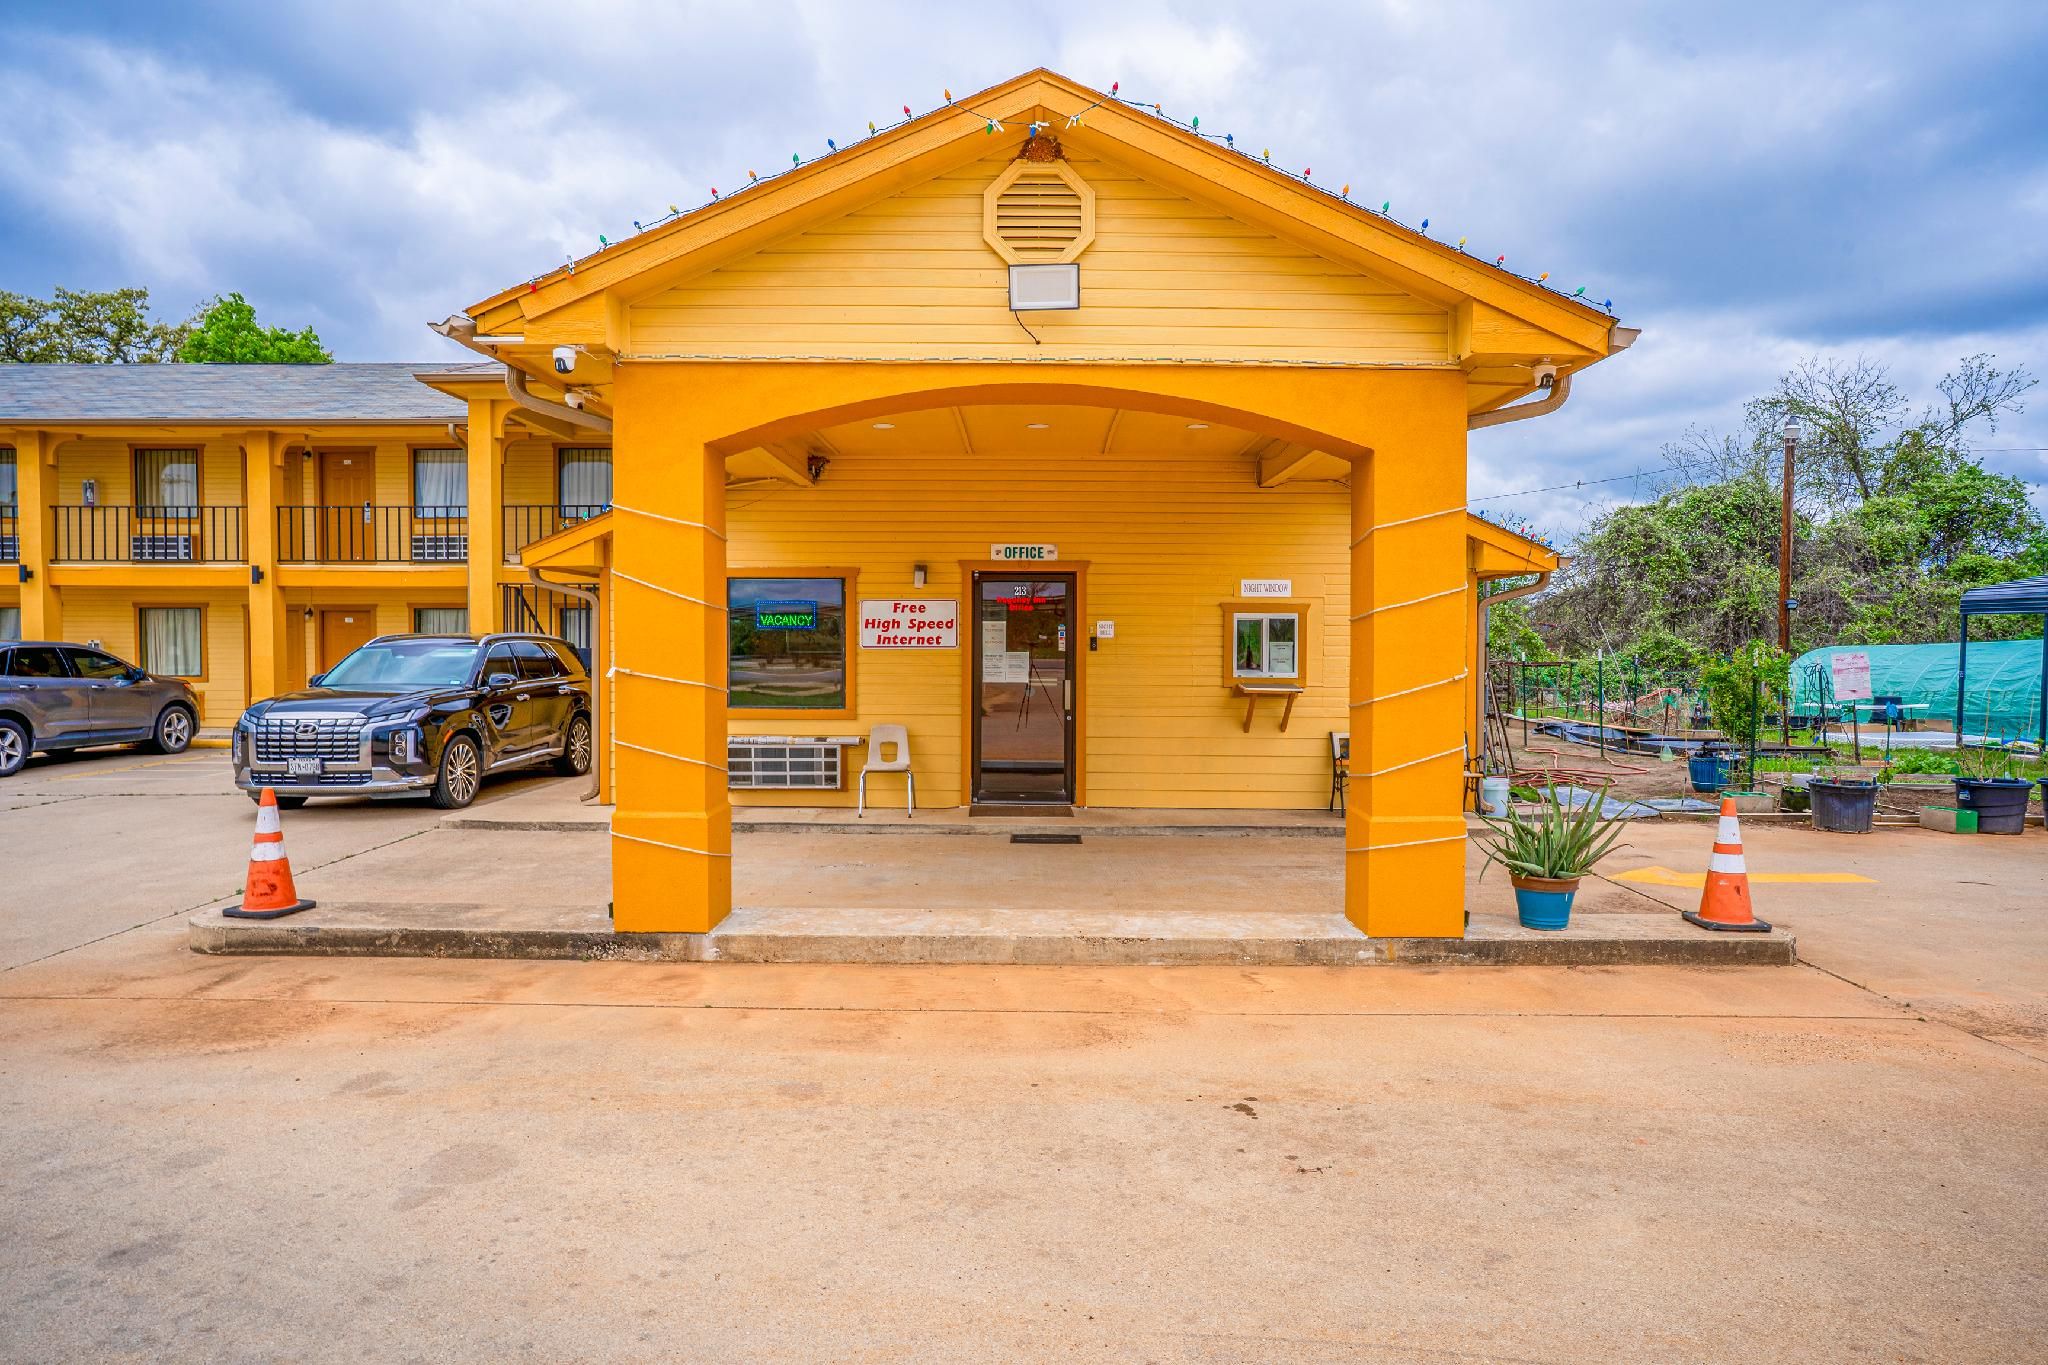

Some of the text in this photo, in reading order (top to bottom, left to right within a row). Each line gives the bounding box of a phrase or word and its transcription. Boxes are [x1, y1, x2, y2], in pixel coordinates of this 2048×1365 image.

[1004, 546, 1044, 559] OFFICE
[1014, 586, 1027, 596] 213
[1263, 583, 1289, 593] WINDOW
[892, 602, 927, 613] Free
[760, 614, 813, 626] VACANCY
[864, 618, 955, 633] High Speed
[876, 634, 942, 645] Internet
